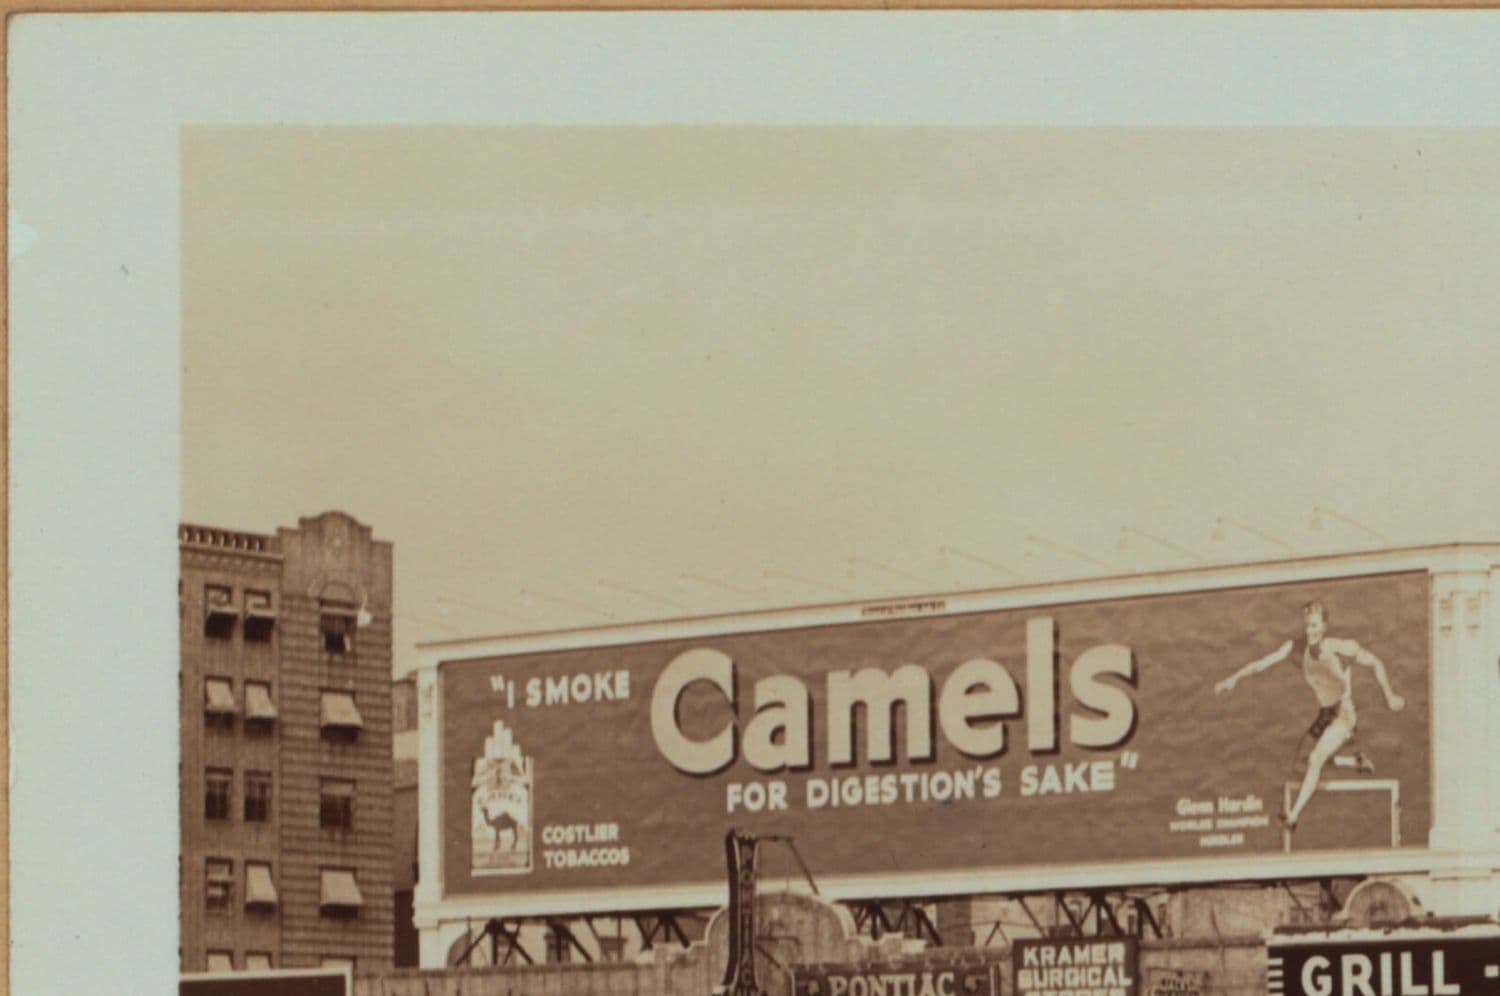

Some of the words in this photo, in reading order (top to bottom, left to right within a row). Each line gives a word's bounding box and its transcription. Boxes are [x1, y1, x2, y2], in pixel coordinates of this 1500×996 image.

[526, 670, 631, 707] SMOKE
[649, 616, 1136, 775] Camels
[726, 782, 788, 813] FOR
[806, 768, 1002, 809] DIGESTION'S
[542, 823, 620, 844] COSTLIER
[543, 847, 631, 869] TOBACCOS
[1023, 942, 1126, 967] KRAMER
[1017, 965, 1133, 990] SURGICAL
